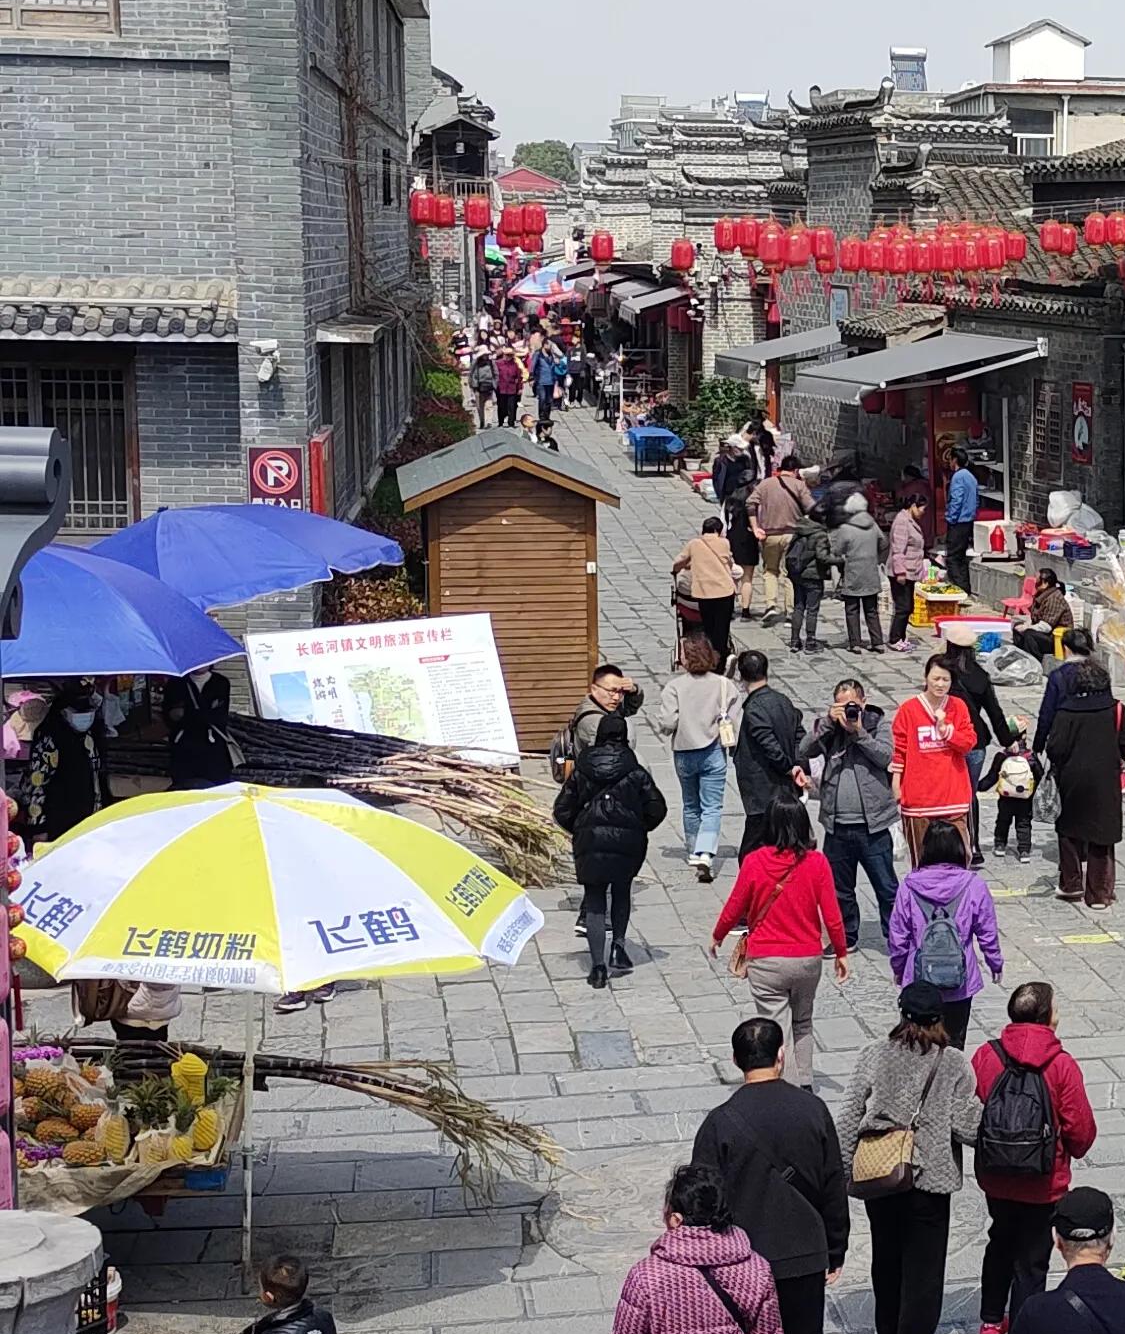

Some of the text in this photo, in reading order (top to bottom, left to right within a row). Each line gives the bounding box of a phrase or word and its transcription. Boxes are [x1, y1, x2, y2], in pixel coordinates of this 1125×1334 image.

[296, 628, 453, 657] 长临河镇文明旅游宣传栏
[19, 881, 84, 939] 飞鹤
[445, 865, 499, 917] 飞鹤奶粉
[122, 926, 256, 961] 飞鹤奶粉
[308, 906, 420, 954] 飞鹤
